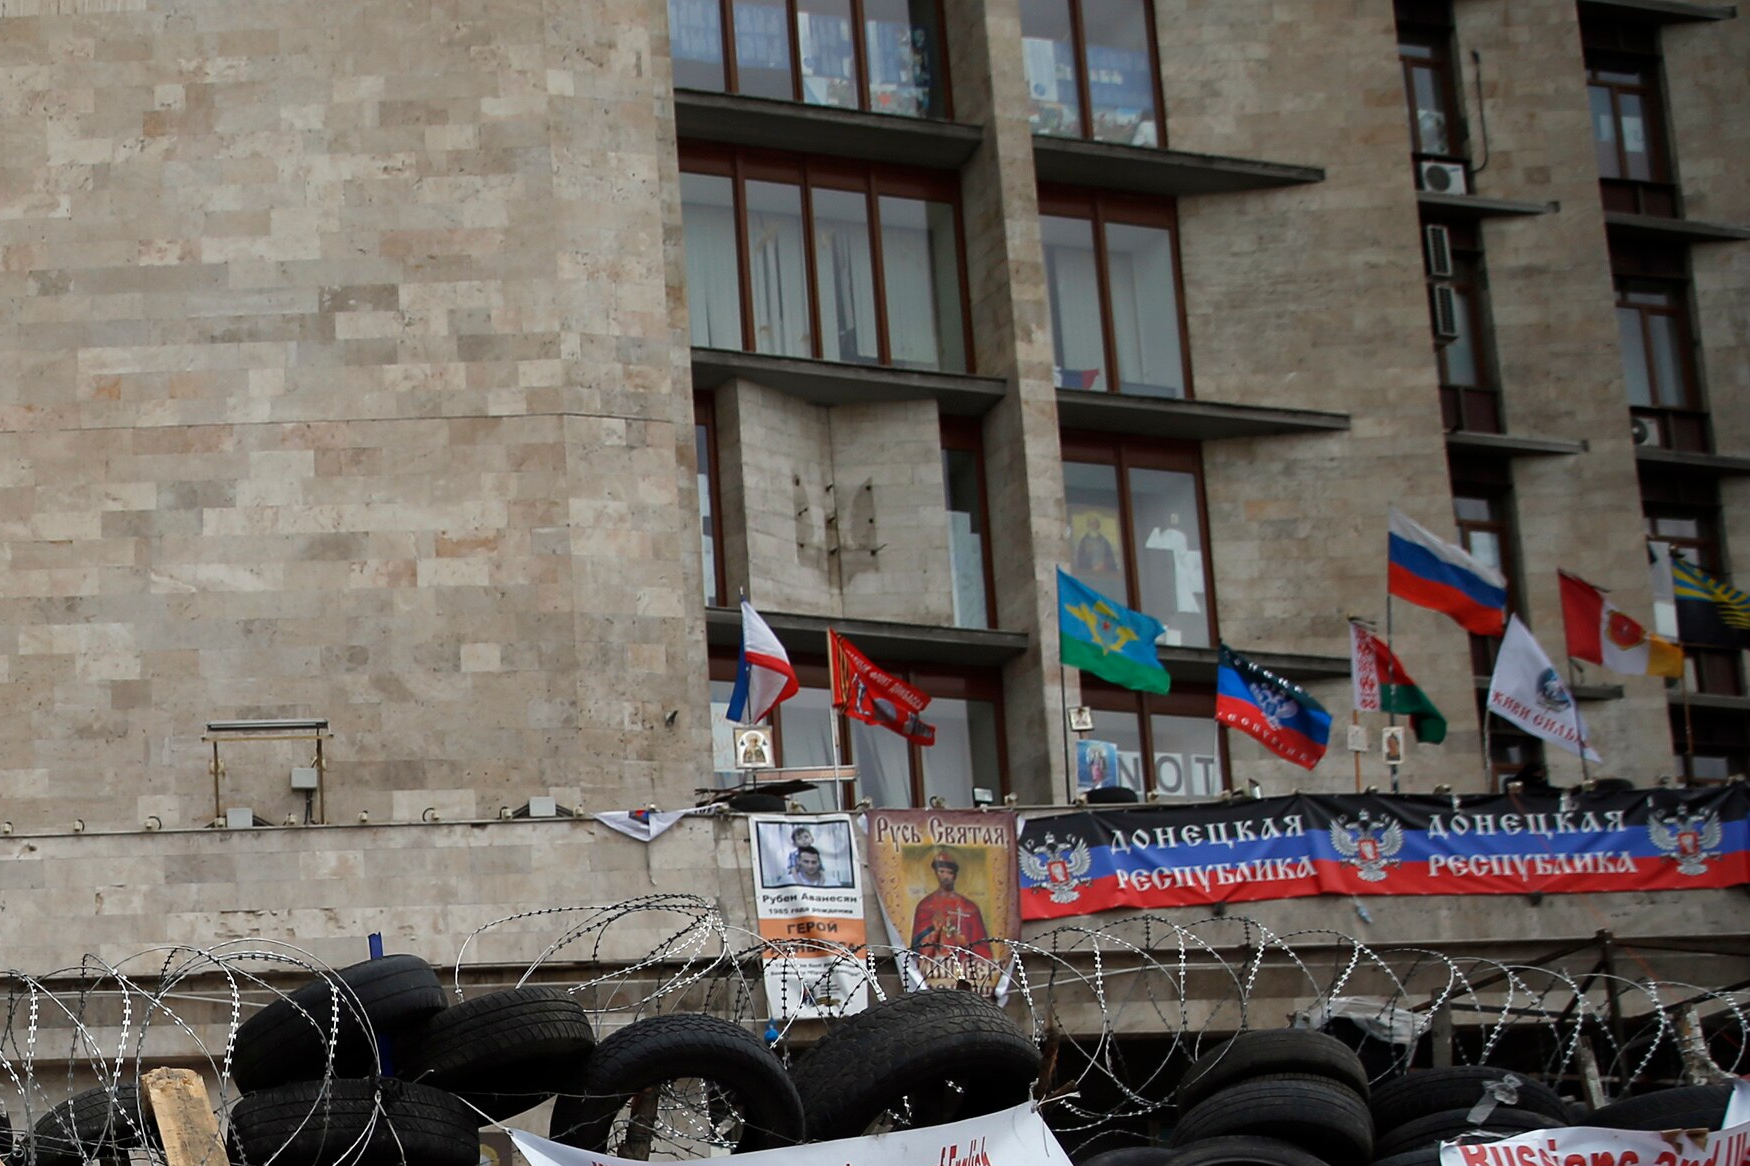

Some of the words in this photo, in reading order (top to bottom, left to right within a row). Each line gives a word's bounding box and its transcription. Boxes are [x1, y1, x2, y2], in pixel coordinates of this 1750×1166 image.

[1116, 755, 1215, 796] NOT
[875, 817, 921, 851] Русь
[1111, 814, 1305, 855] ДОНЕЦКАЯ
[1428, 810, 1626, 840] ДОНЕЦКАЯ
[1116, 855, 1318, 893] РЕСПУБЛИКА
[1428, 851, 1638, 882] РЕСПУБЛИКА
[762, 894, 797, 904] Рубен
[801, 892, 858, 903] Аванесян
[787, 920, 838, 934] ГЕРОЙ
